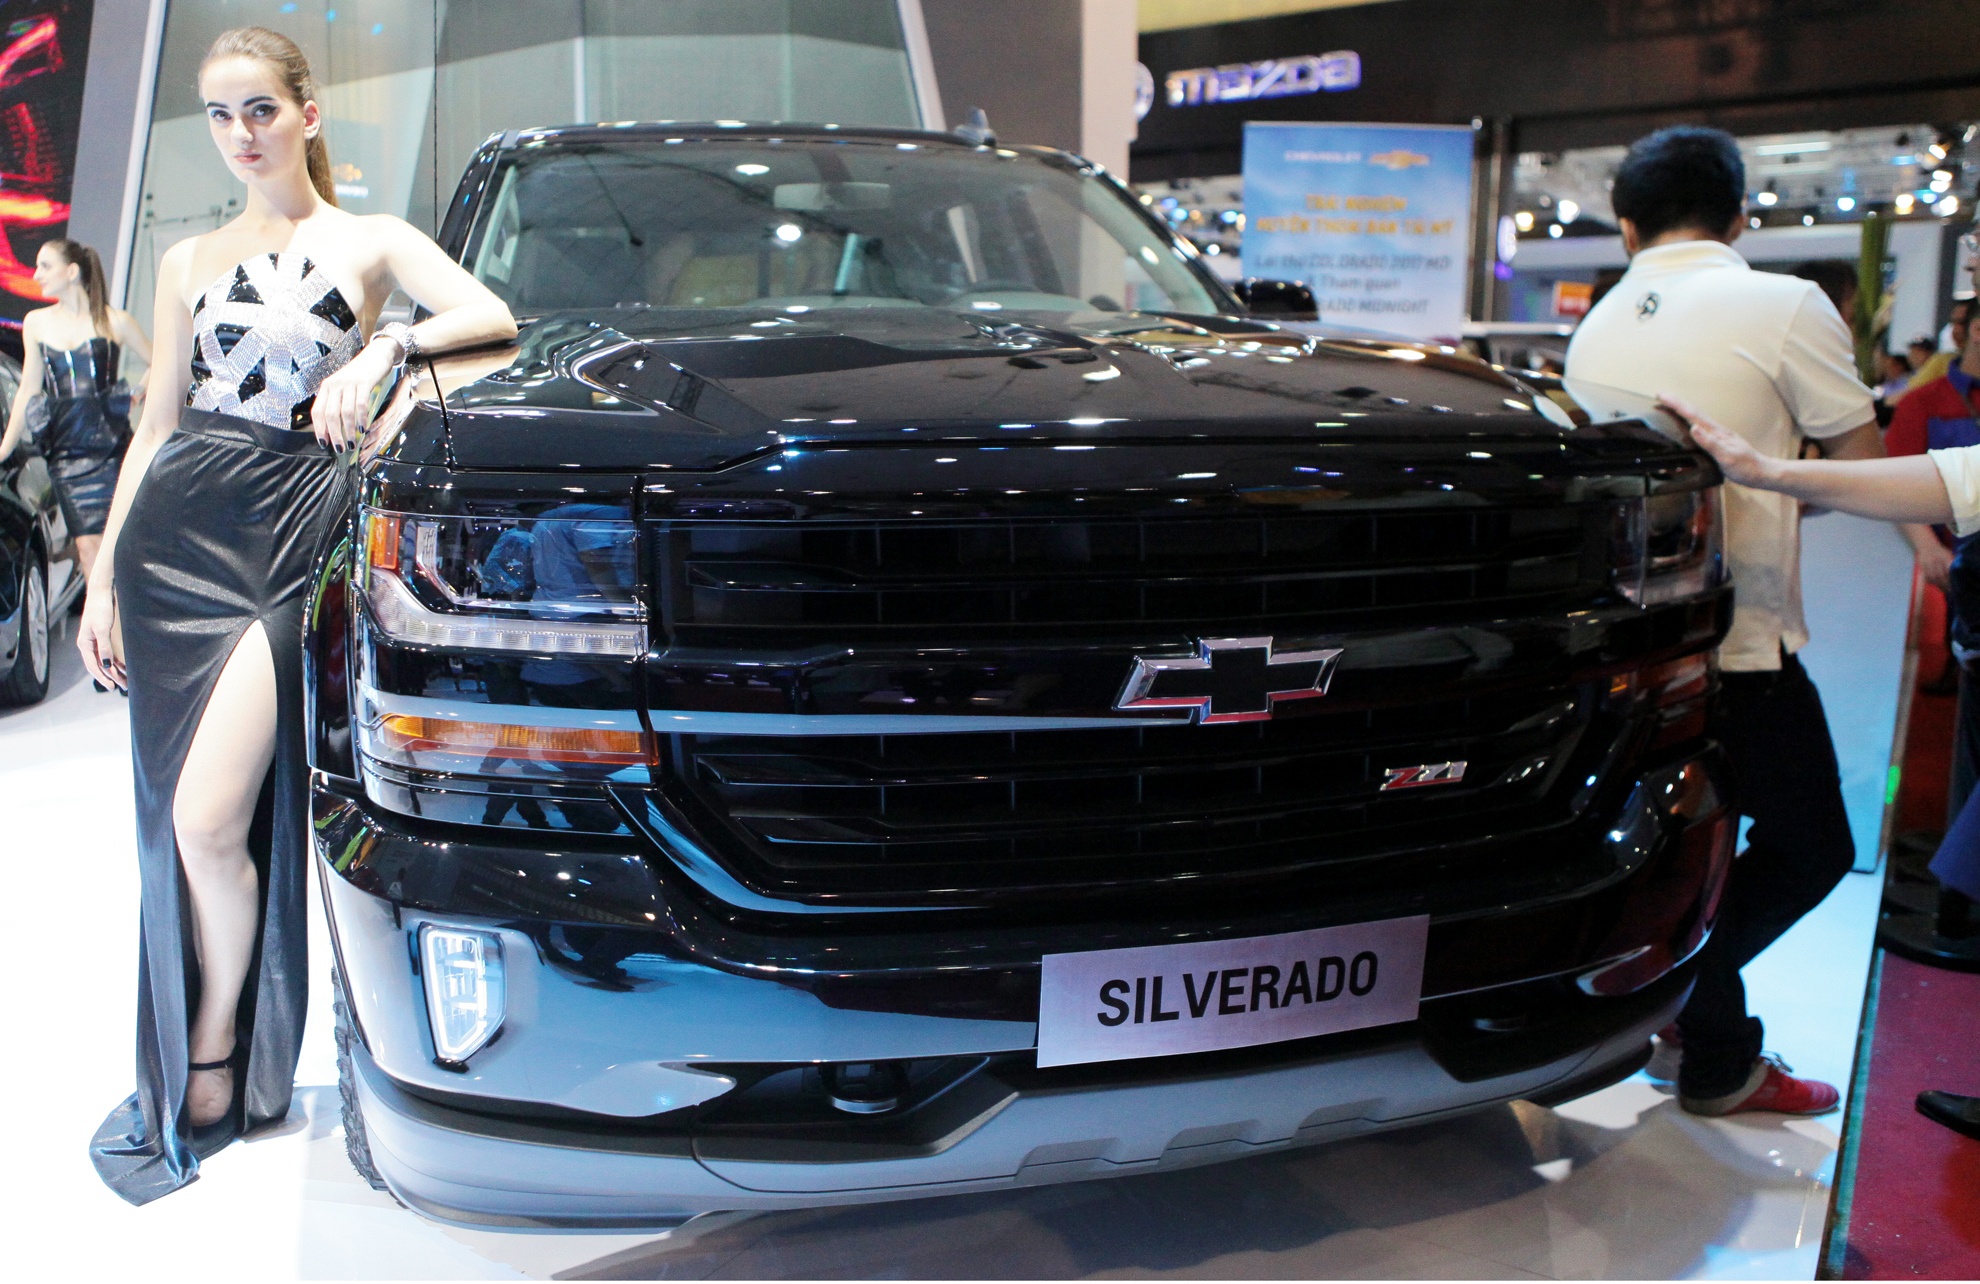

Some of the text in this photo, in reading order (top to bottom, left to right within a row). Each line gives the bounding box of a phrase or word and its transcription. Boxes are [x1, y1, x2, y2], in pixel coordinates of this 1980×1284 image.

[1166, 50, 1362, 107] mazda
[1380, 761, 1467, 791] Z71
[1097, 950, 1378, 1027] SILVERADO
